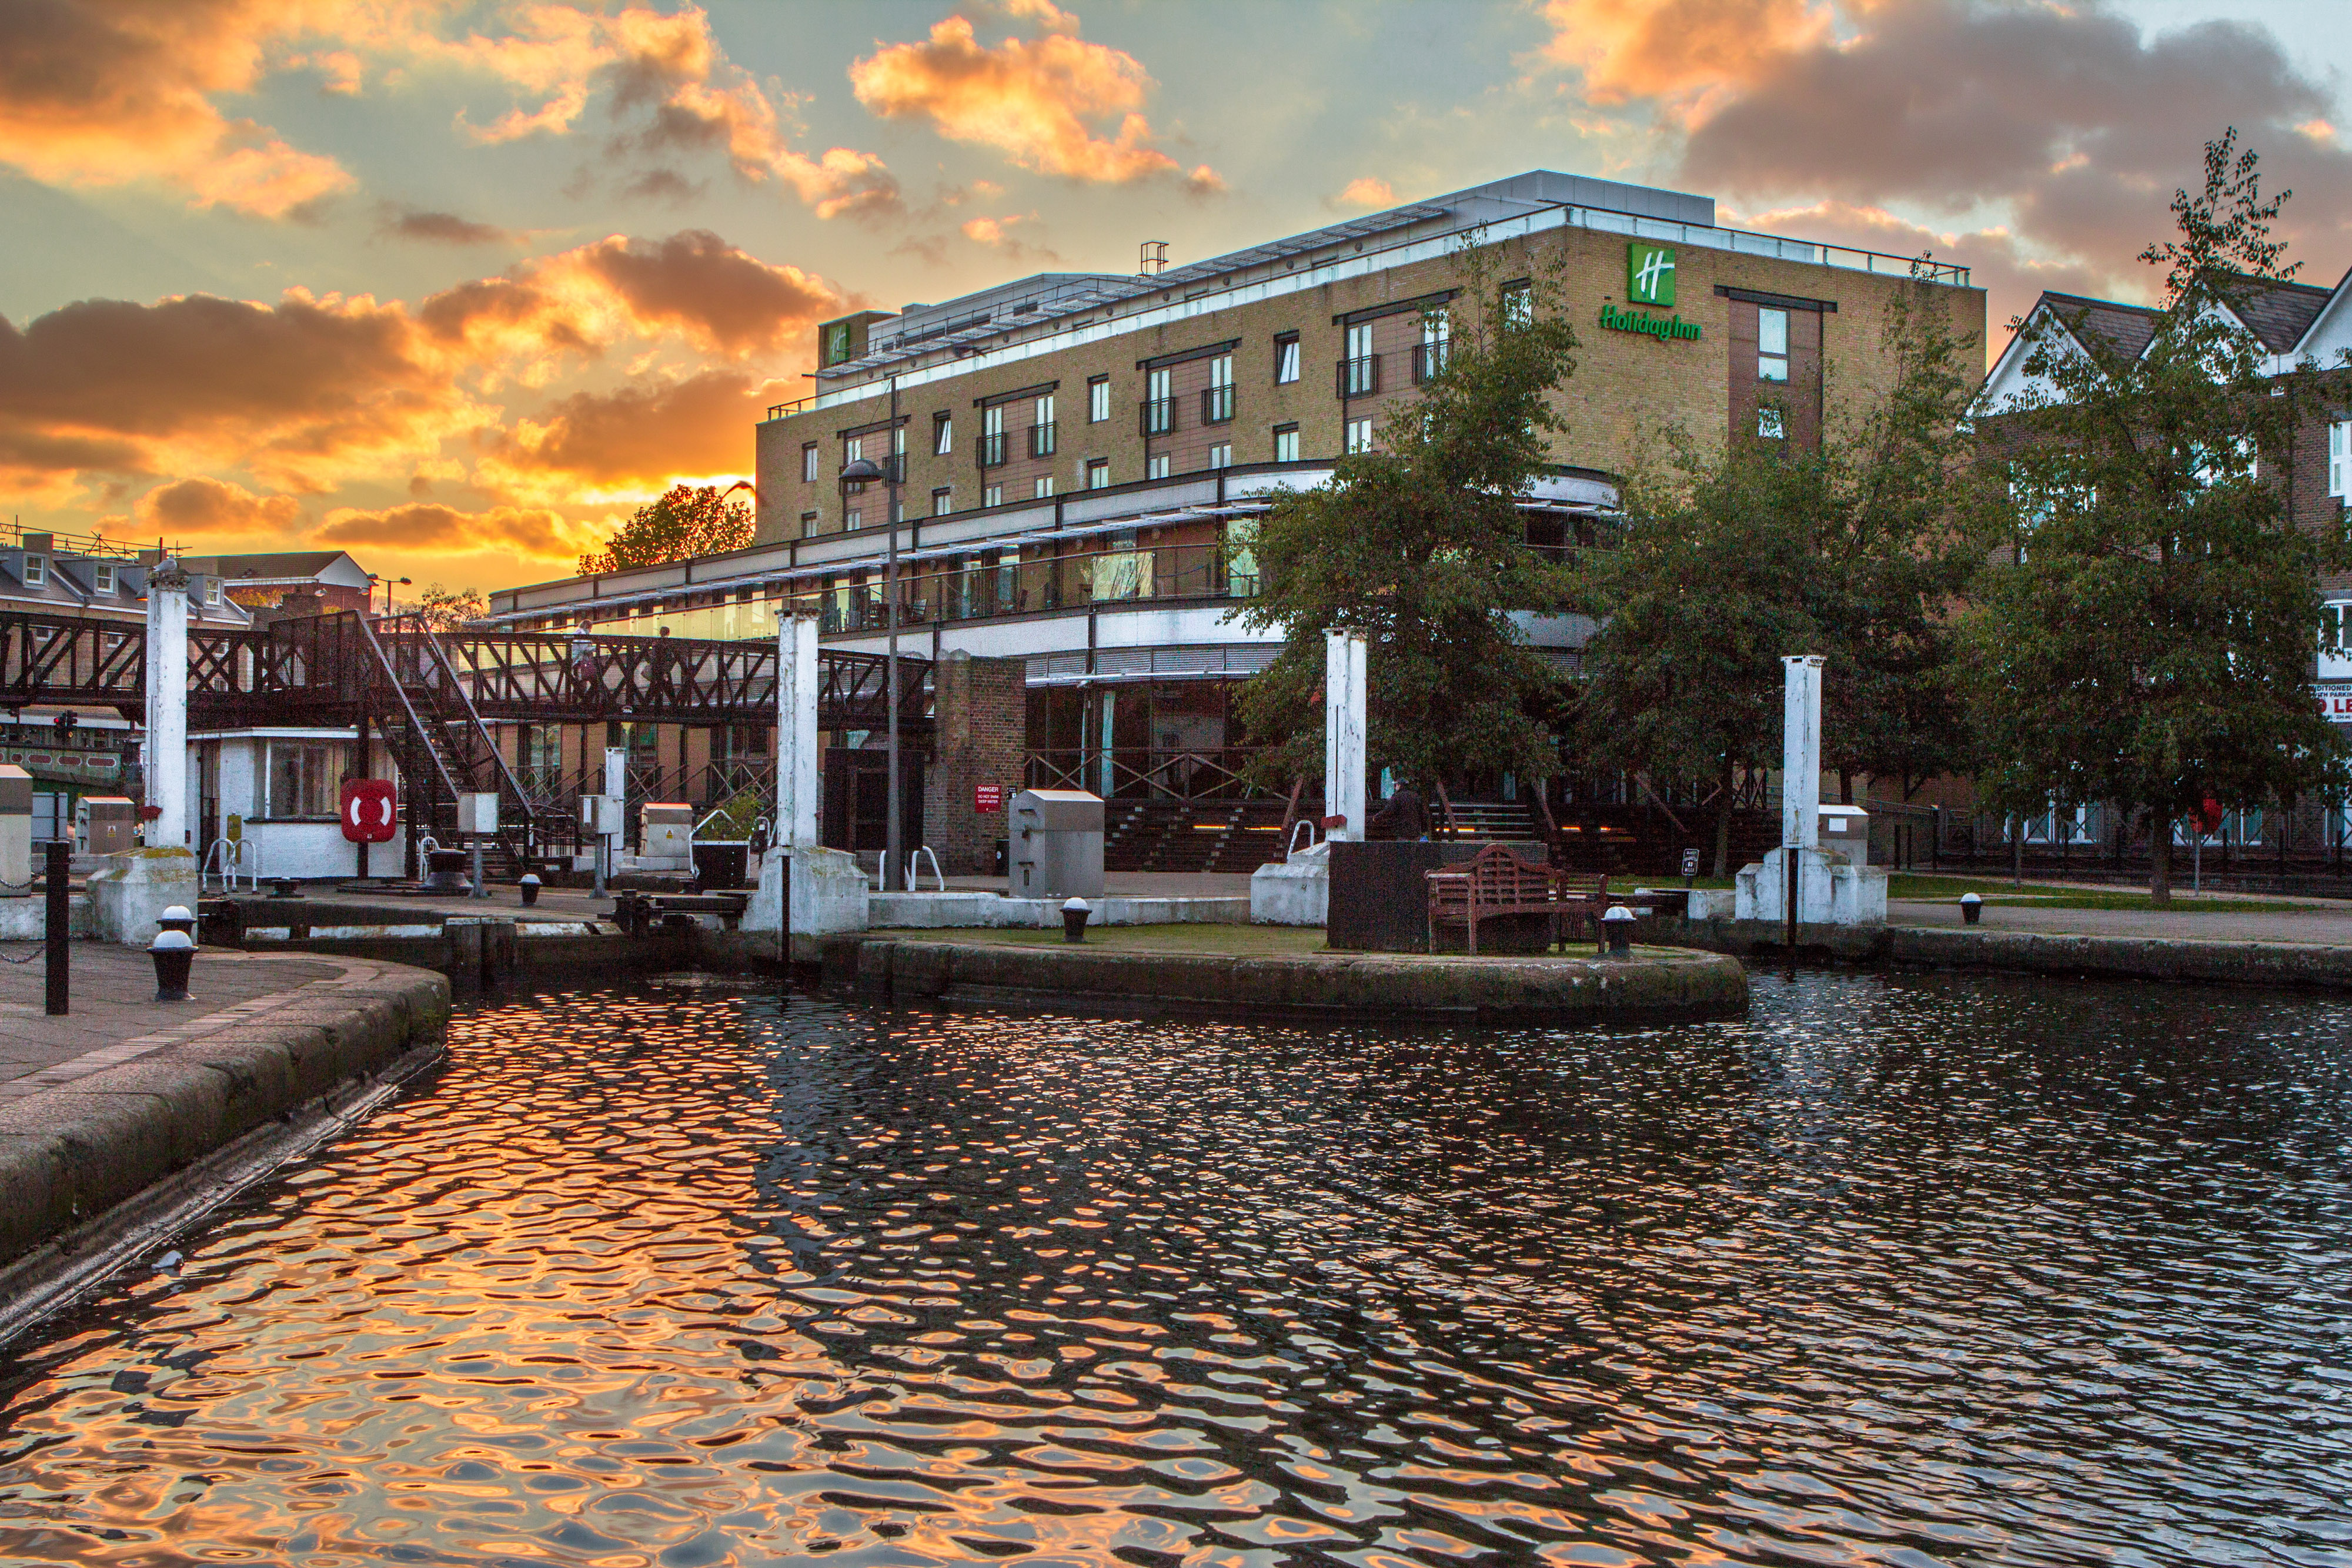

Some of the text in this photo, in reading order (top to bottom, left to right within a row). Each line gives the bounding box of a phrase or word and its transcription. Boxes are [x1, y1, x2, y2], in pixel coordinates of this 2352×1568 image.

[1600, 305, 1702, 341] Holiday Inn
[2334, 698, 2352, 713] LE
